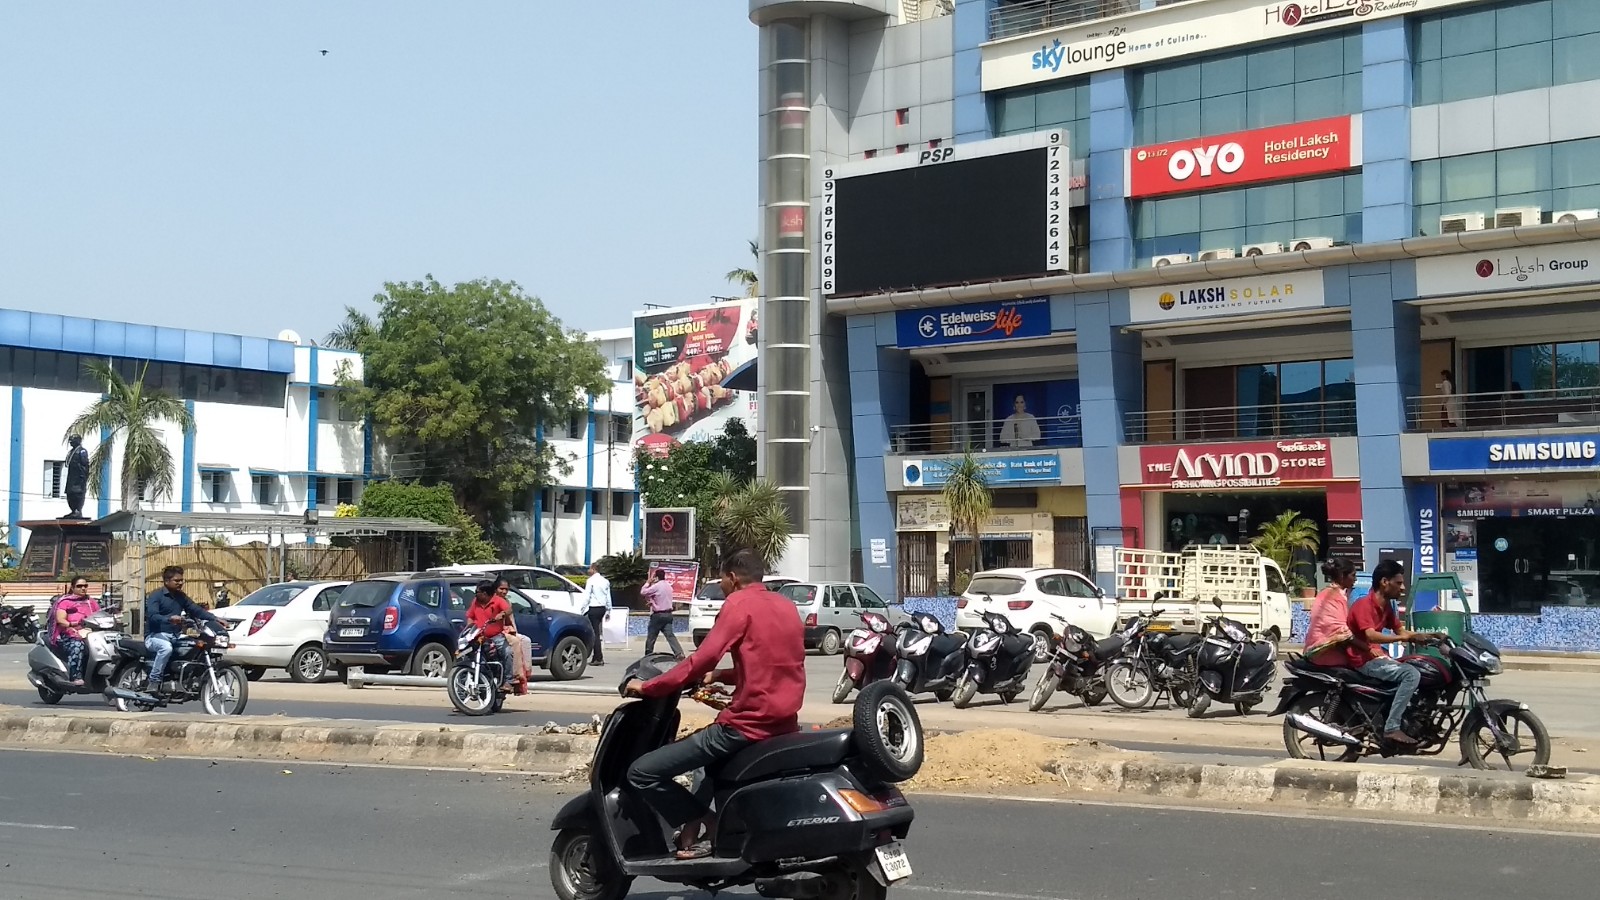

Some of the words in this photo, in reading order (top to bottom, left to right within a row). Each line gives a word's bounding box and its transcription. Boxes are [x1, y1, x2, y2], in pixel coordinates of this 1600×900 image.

[1032, 38, 1066, 73] sky
[1067, 41, 1127, 64] lounge
[1128, 43, 1151, 52] Home
[1264, 137, 1298, 152] Hotel
[1300, 131, 1339, 147] Laksh
[919, 146, 954, 165] PSP
[1168, 142, 1245, 180] OYO
[1264, 147, 1330, 164] Residency
[1049, 132, 1060, 265] 9723432645
[824, 168, 833, 290] 9978767696
[1497, 256, 1545, 282] Laksh
[1549, 259, 1589, 271] Group
[1180, 286, 1225, 306] LAKSH
[1230, 283, 1294, 301] SOLAR
[1197, 302, 1243, 311] POWERING
[652, 320, 707, 340] BARBEQUE
[940, 310, 997, 325] Edelweiss
[995, 306, 1024, 337] life
[941, 325, 972, 338] Tokio
[1489, 441, 1596, 462] SAMSUNG
[1043, 459, 1057, 467] India
[1147, 463, 1172, 473] THE
[1281, 457, 1327, 468] STORE
[1171, 478, 1221, 489] FASHIONING
[1220, 476, 1281, 488] POSSIBILITIES
[1457, 509, 1495, 517] SAMSUNG
[1527, 508, 1560, 516] SMART
[1563, 507, 1595, 515] PLAZA
[787, 816, 840, 827] ETERNO
